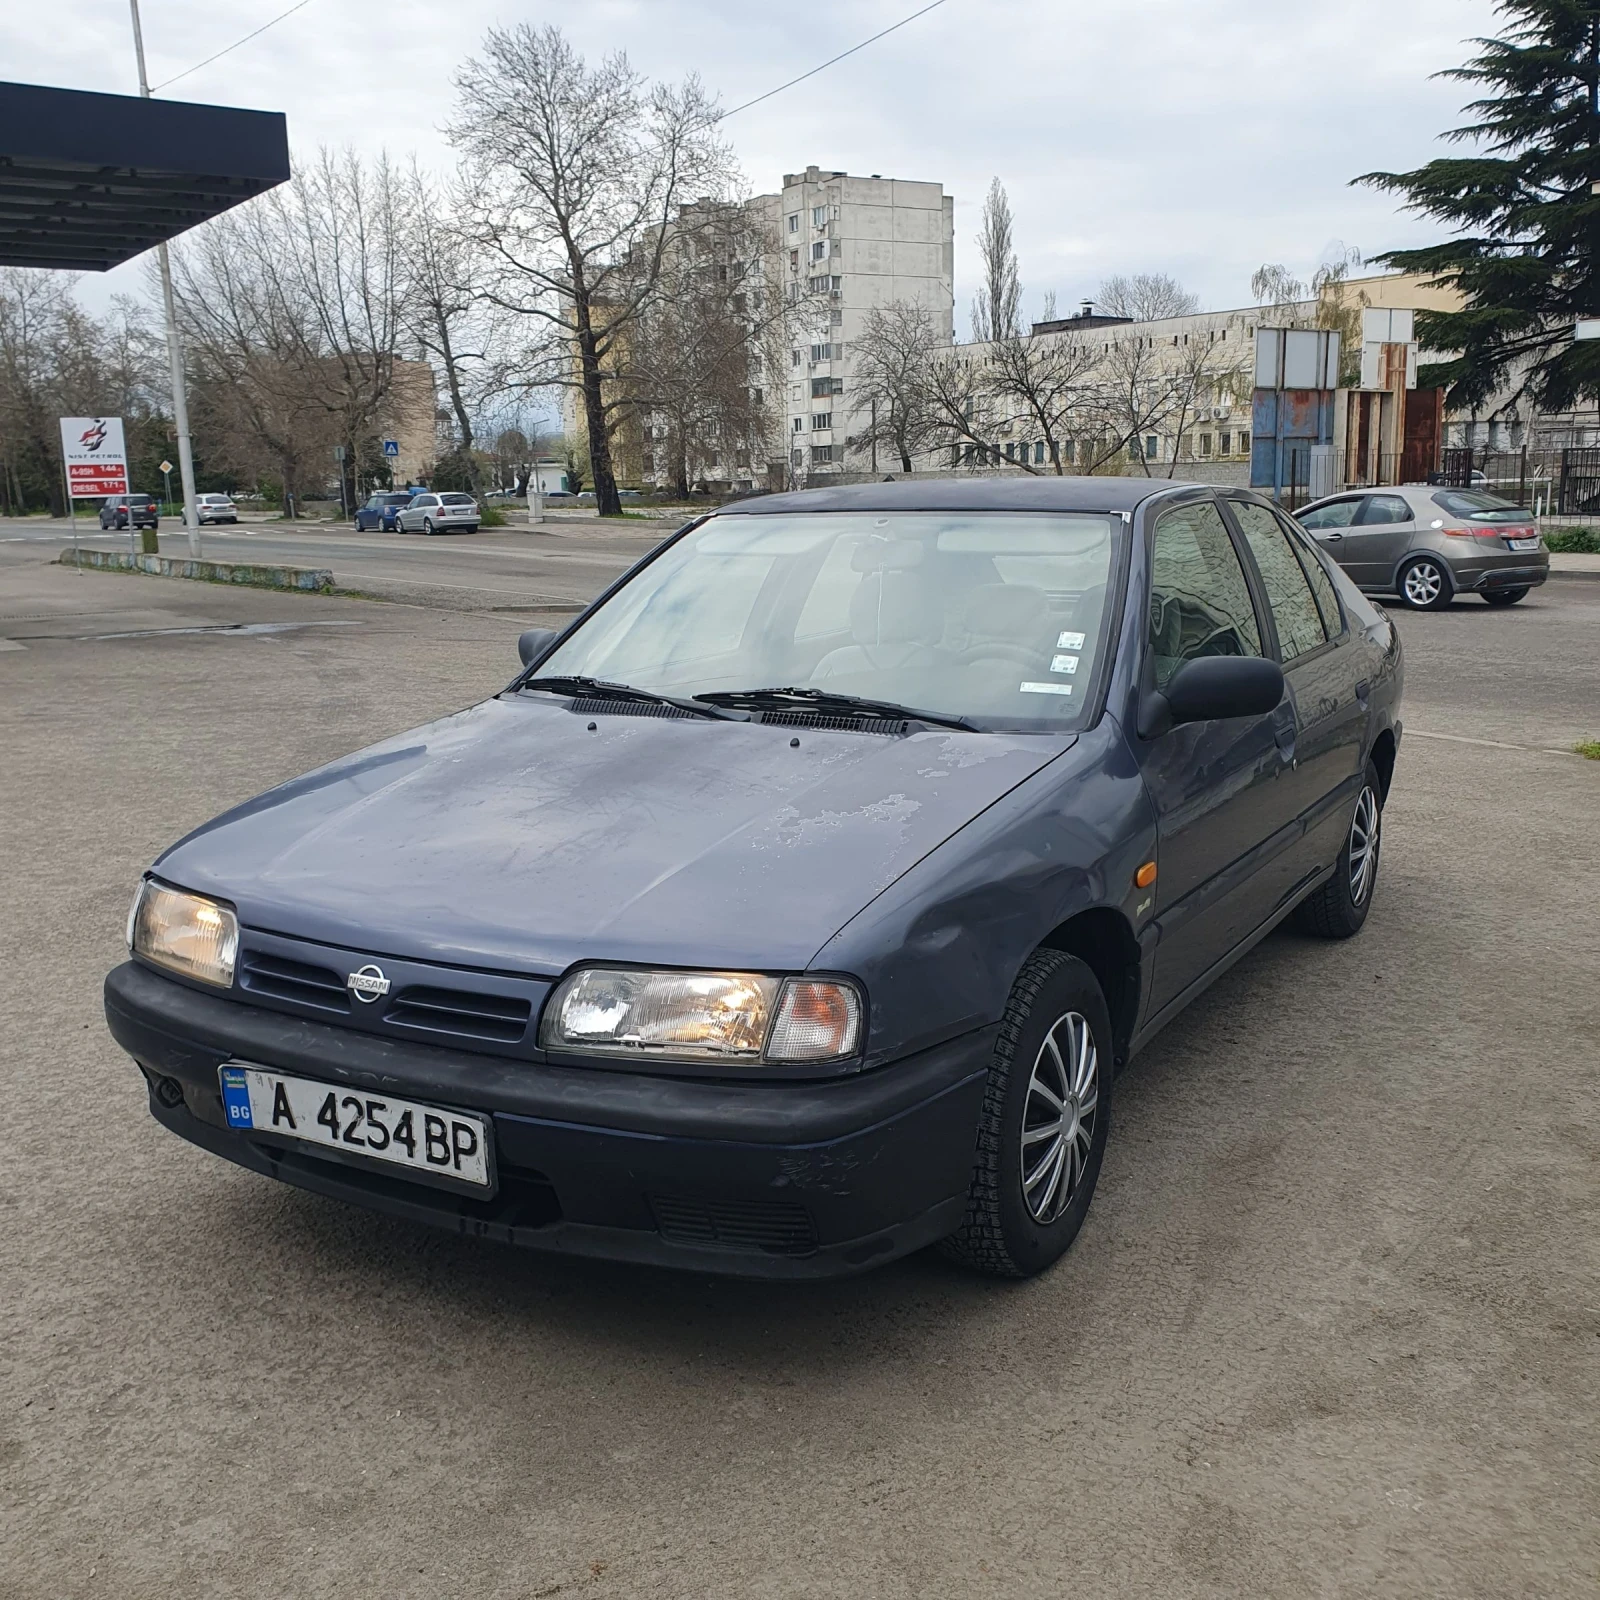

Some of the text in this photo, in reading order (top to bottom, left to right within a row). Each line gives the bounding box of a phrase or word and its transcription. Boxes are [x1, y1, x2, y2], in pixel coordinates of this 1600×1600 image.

[73, 484, 100, 493] DIESEL
[348, 975, 387, 991] NISSAN
[230, 1105, 250, 1119] BG
